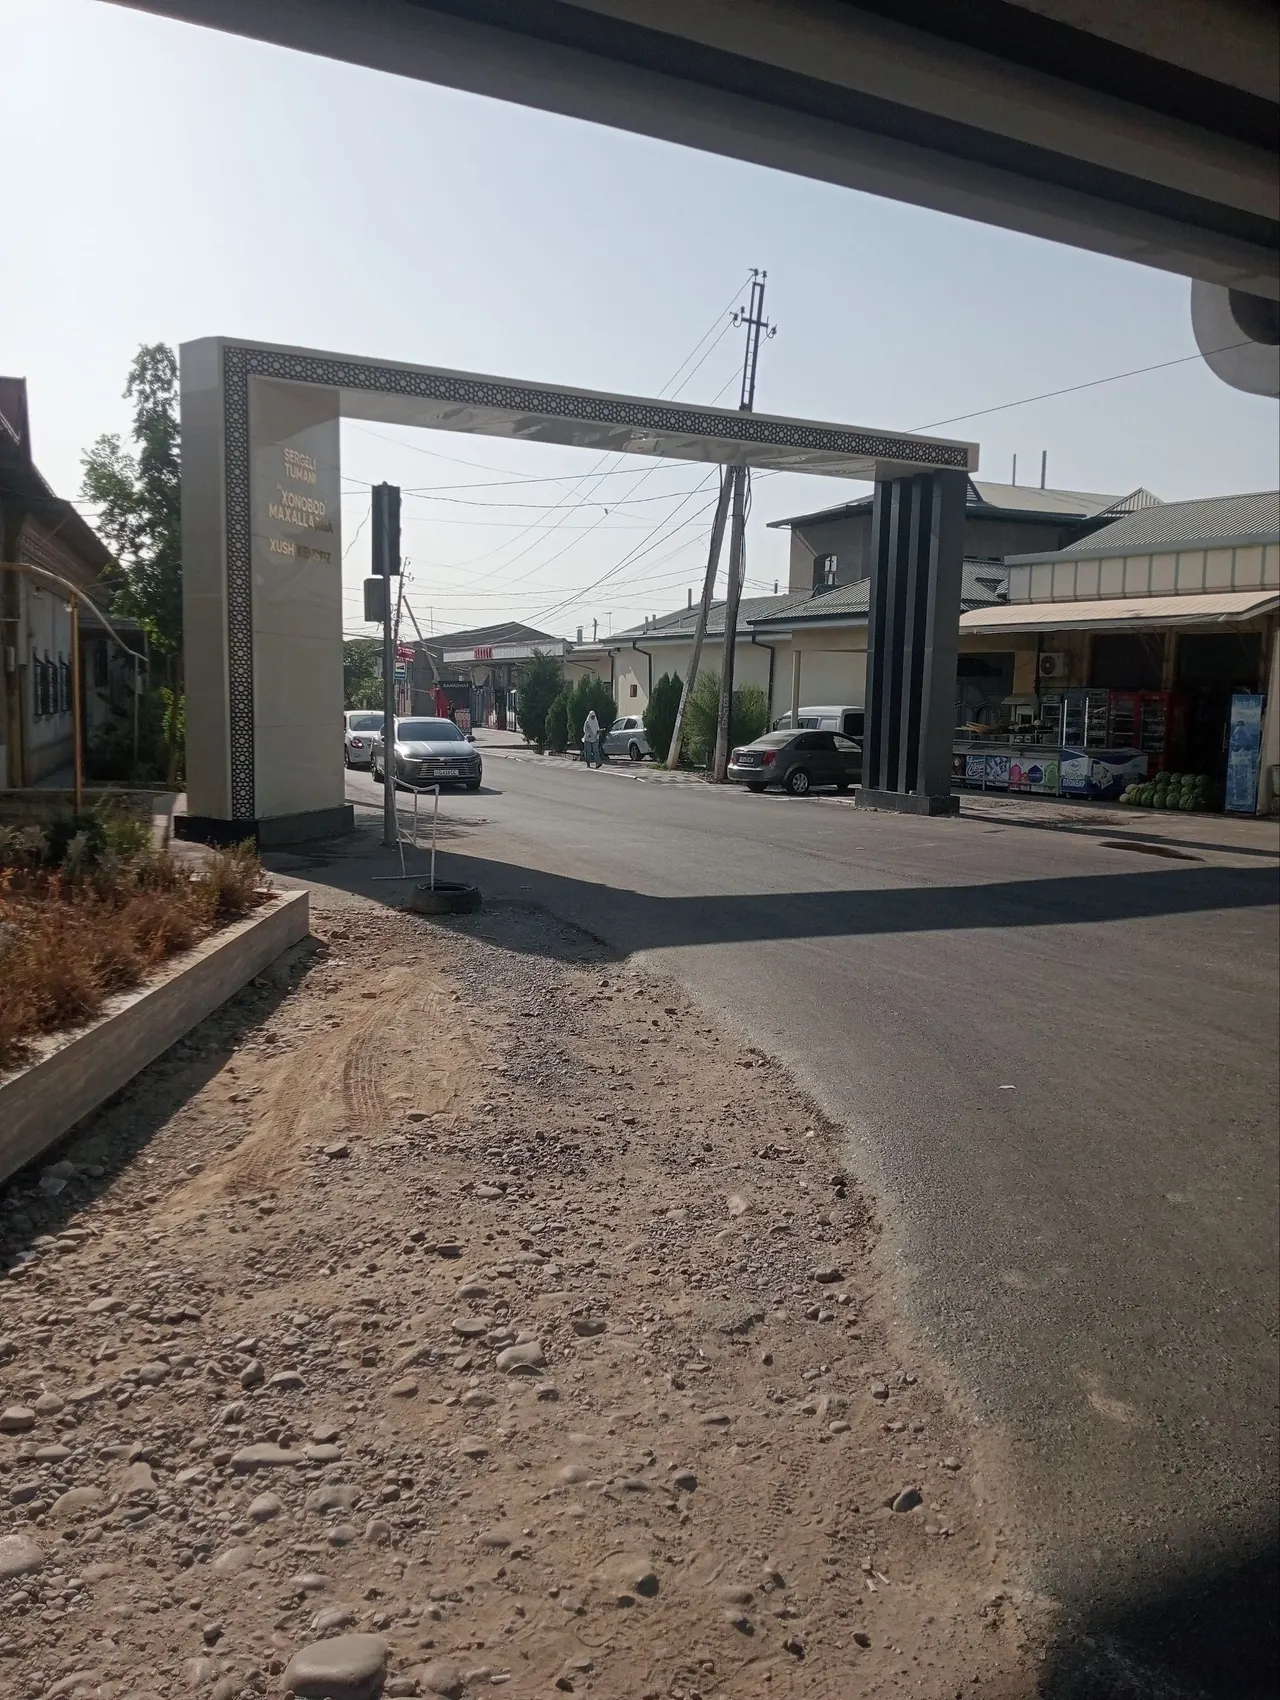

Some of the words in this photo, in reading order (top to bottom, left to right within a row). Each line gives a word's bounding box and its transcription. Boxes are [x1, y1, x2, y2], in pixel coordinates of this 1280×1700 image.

[284, 447, 316, 471] SERGELI
[285, 463, 316, 486] TUMANI
[269, 537, 294, 556] XUSH
